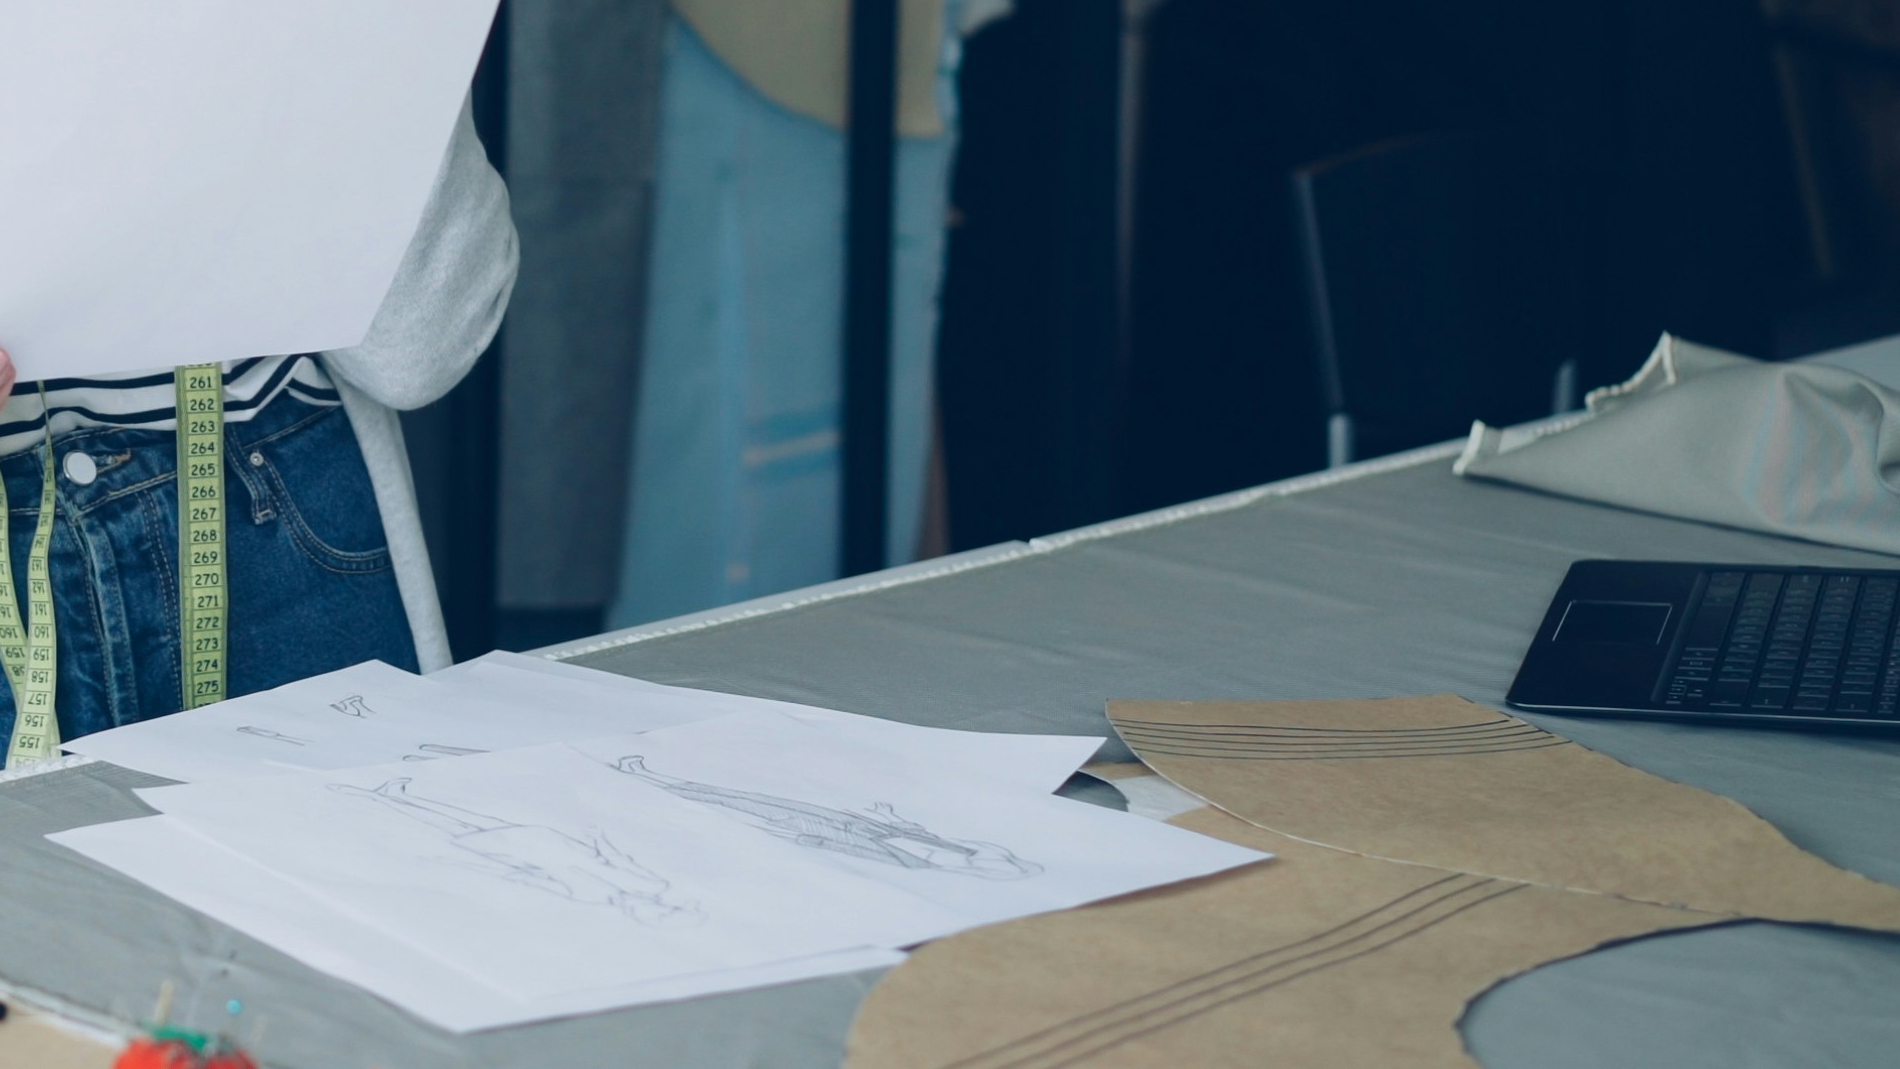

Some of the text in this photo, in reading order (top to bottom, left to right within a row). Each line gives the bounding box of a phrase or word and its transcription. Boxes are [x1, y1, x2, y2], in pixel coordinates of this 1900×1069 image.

[189, 376, 212, 389] 261
[190, 398, 215, 411] 262
[190, 420, 215, 433] 263
[190, 441, 215, 454] 264
[191, 463, 216, 476] 265
[192, 485, 216, 498] 266
[192, 507, 217, 520] 267
[193, 529, 217, 542] 268
[193, 551, 218, 564] 269
[195, 572, 219, 586] 270
[32, 581, 45, 594] 162
[197, 595, 219, 608] 271
[34, 603, 47, 616] 161
[196, 616, 219, 629] 272
[33, 626, 50, 639] 160
[195, 637, 219, 651] 273
[5, 647, 26, 659] 159
[33, 648, 50, 661] 159
[11, 666, 25, 677] 58
[196, 659, 218, 672] 274
[31, 671, 49, 683] 158
[196, 680, 219, 694] 275
[27, 693, 47, 706] 157
[24, 715, 44, 727] 156
[18, 736, 40, 749] 155
